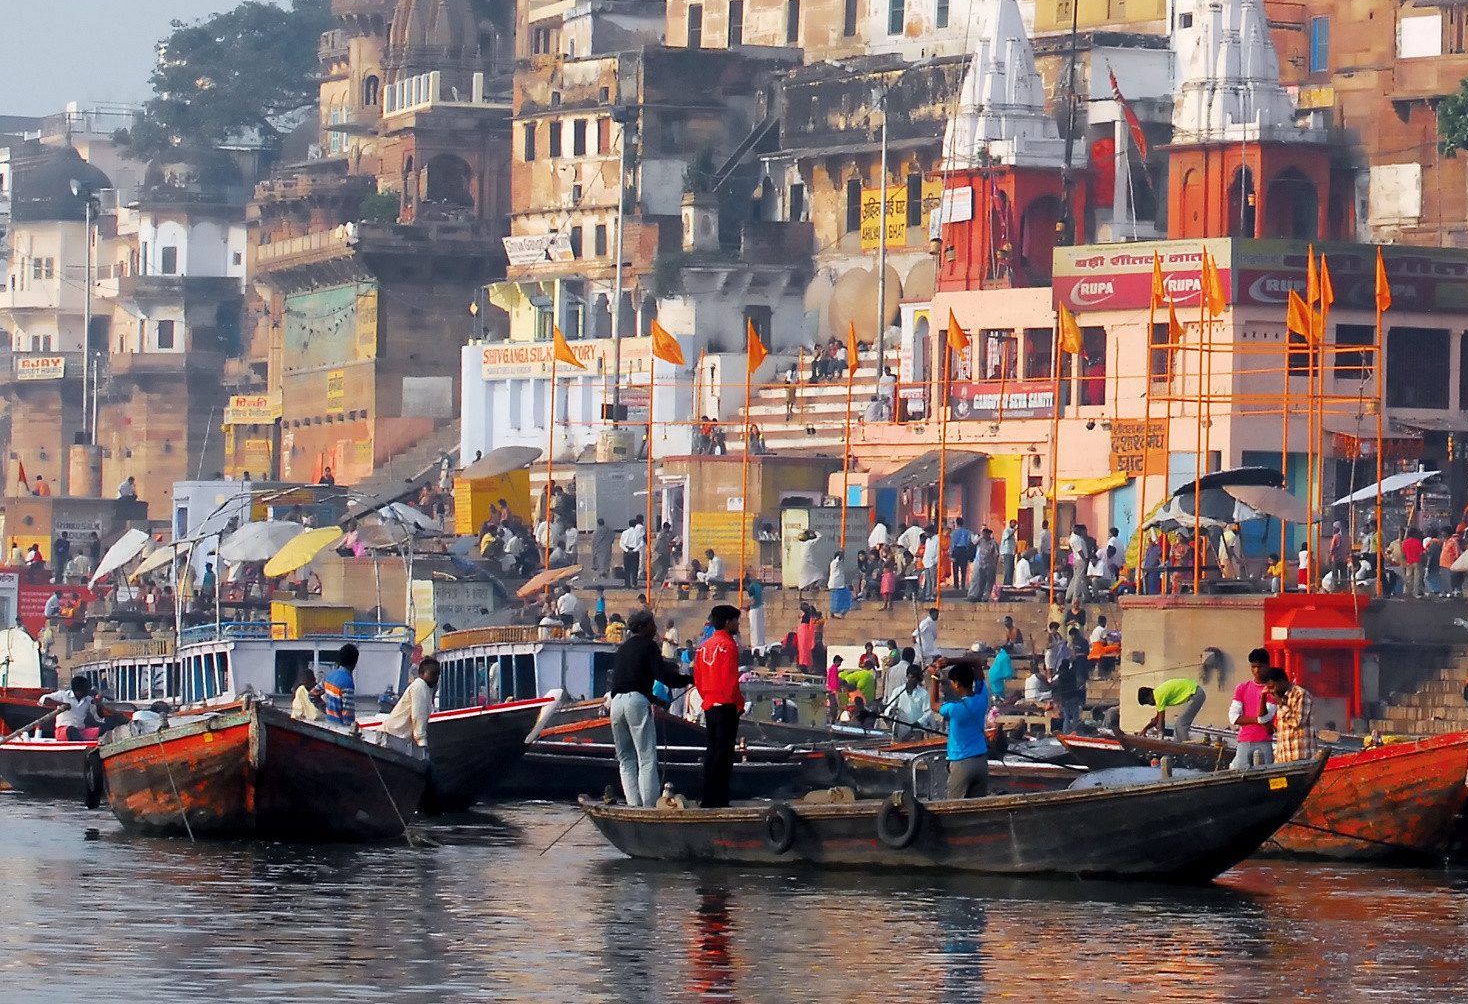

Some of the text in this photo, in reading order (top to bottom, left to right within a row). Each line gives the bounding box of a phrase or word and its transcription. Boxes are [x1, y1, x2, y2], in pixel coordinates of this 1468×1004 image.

[1169, 253, 1203, 263] मात
[1080, 282, 1114, 296] RUPA
[1168, 279, 1202, 292] RUPA
[1266, 279, 1307, 292] RUP
[530, 346, 552, 362] SILK
